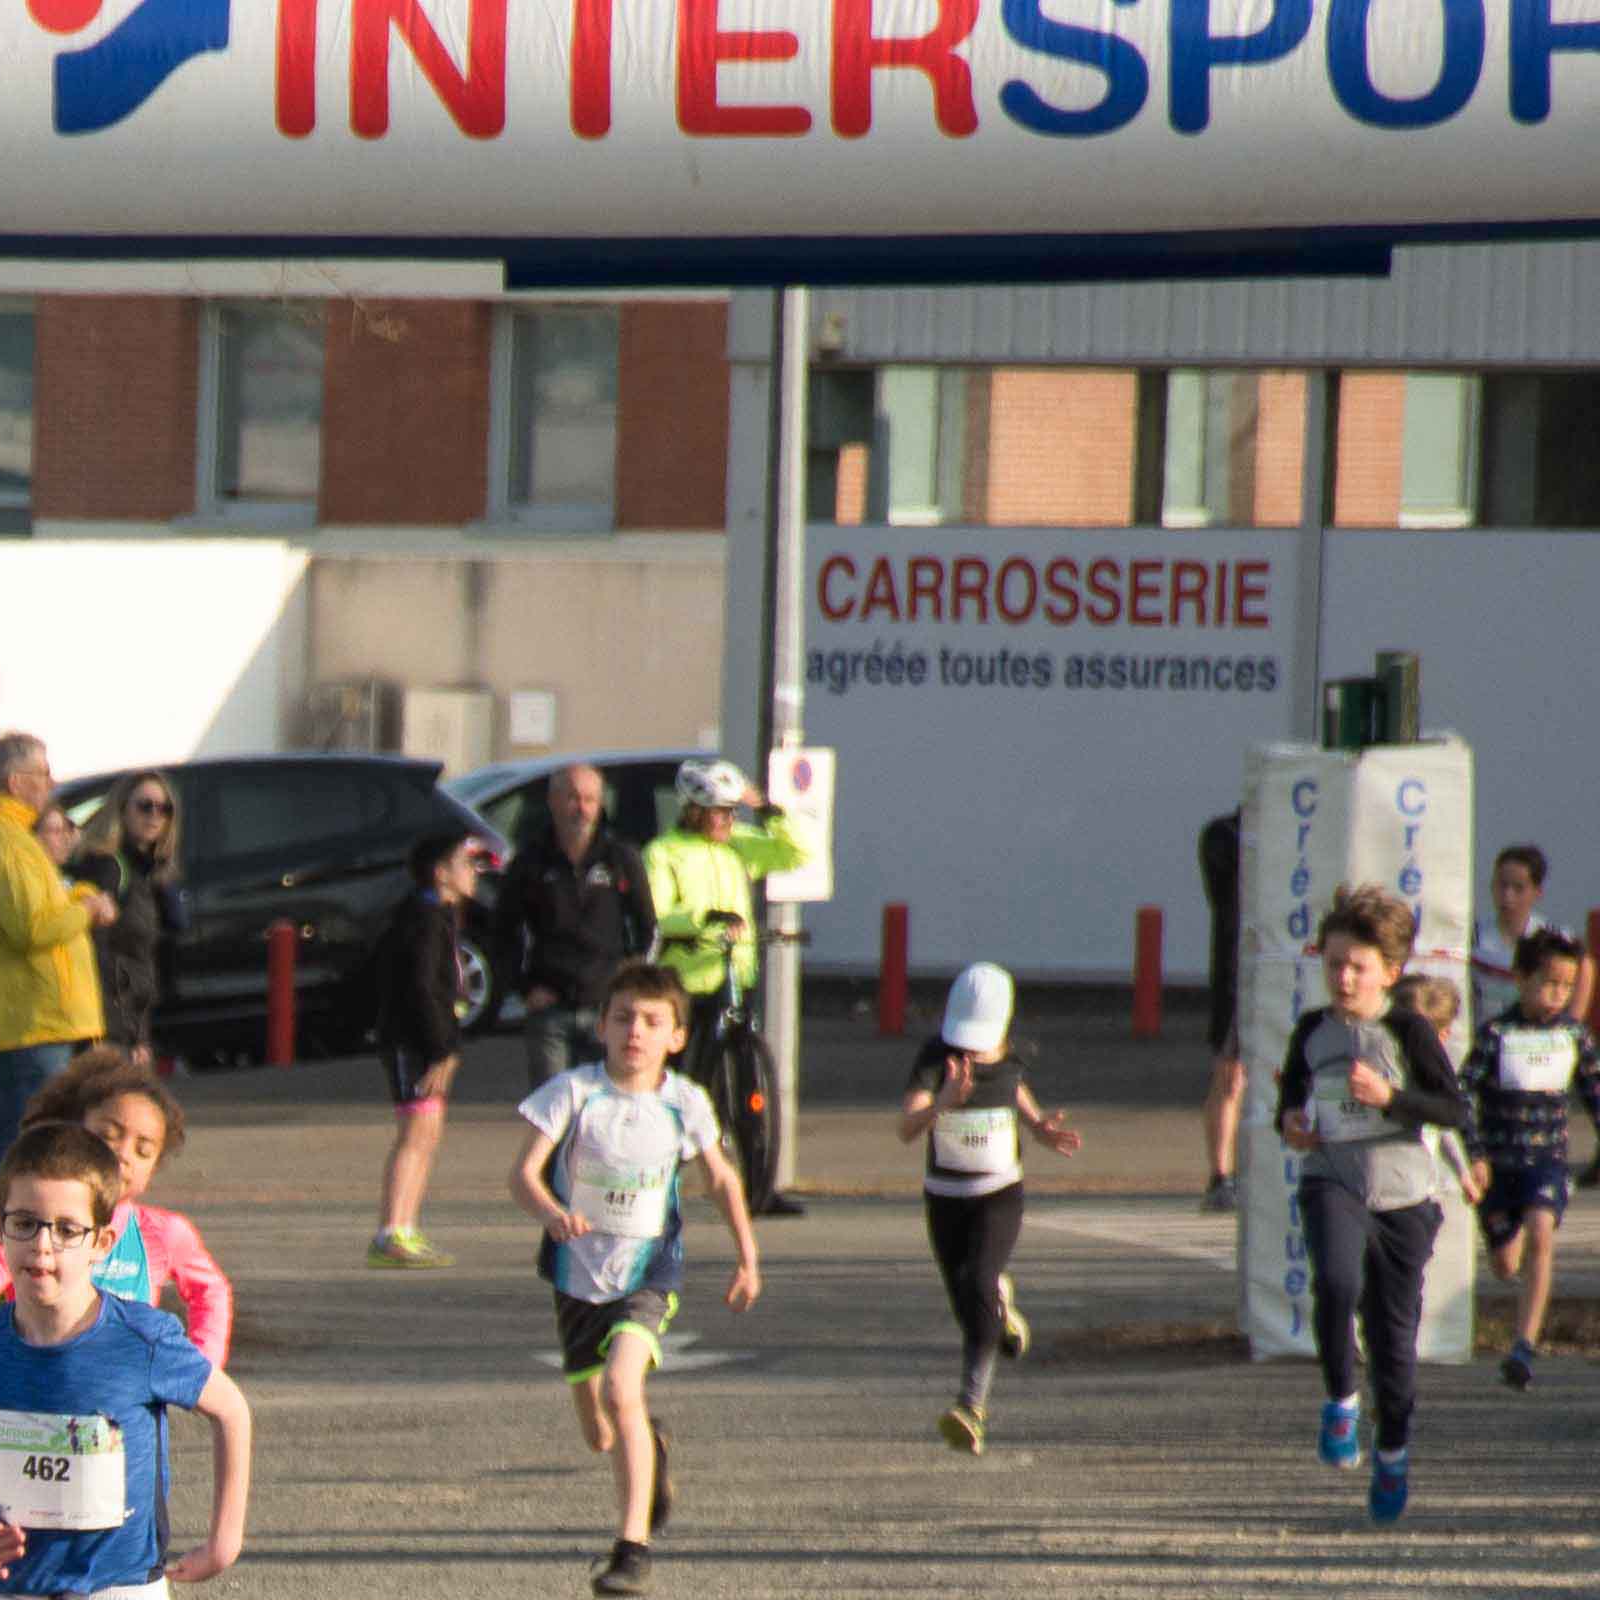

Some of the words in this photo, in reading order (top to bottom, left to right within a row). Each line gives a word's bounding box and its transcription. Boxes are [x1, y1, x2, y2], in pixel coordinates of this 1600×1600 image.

[816, 555, 1270, 628] CARROSSERIE
[806, 640, 928, 693] agréée
[939, 648, 1052, 690] toutes
[1064, 651, 1278, 693] assurances
[23, 1456, 70, 1481] 462
